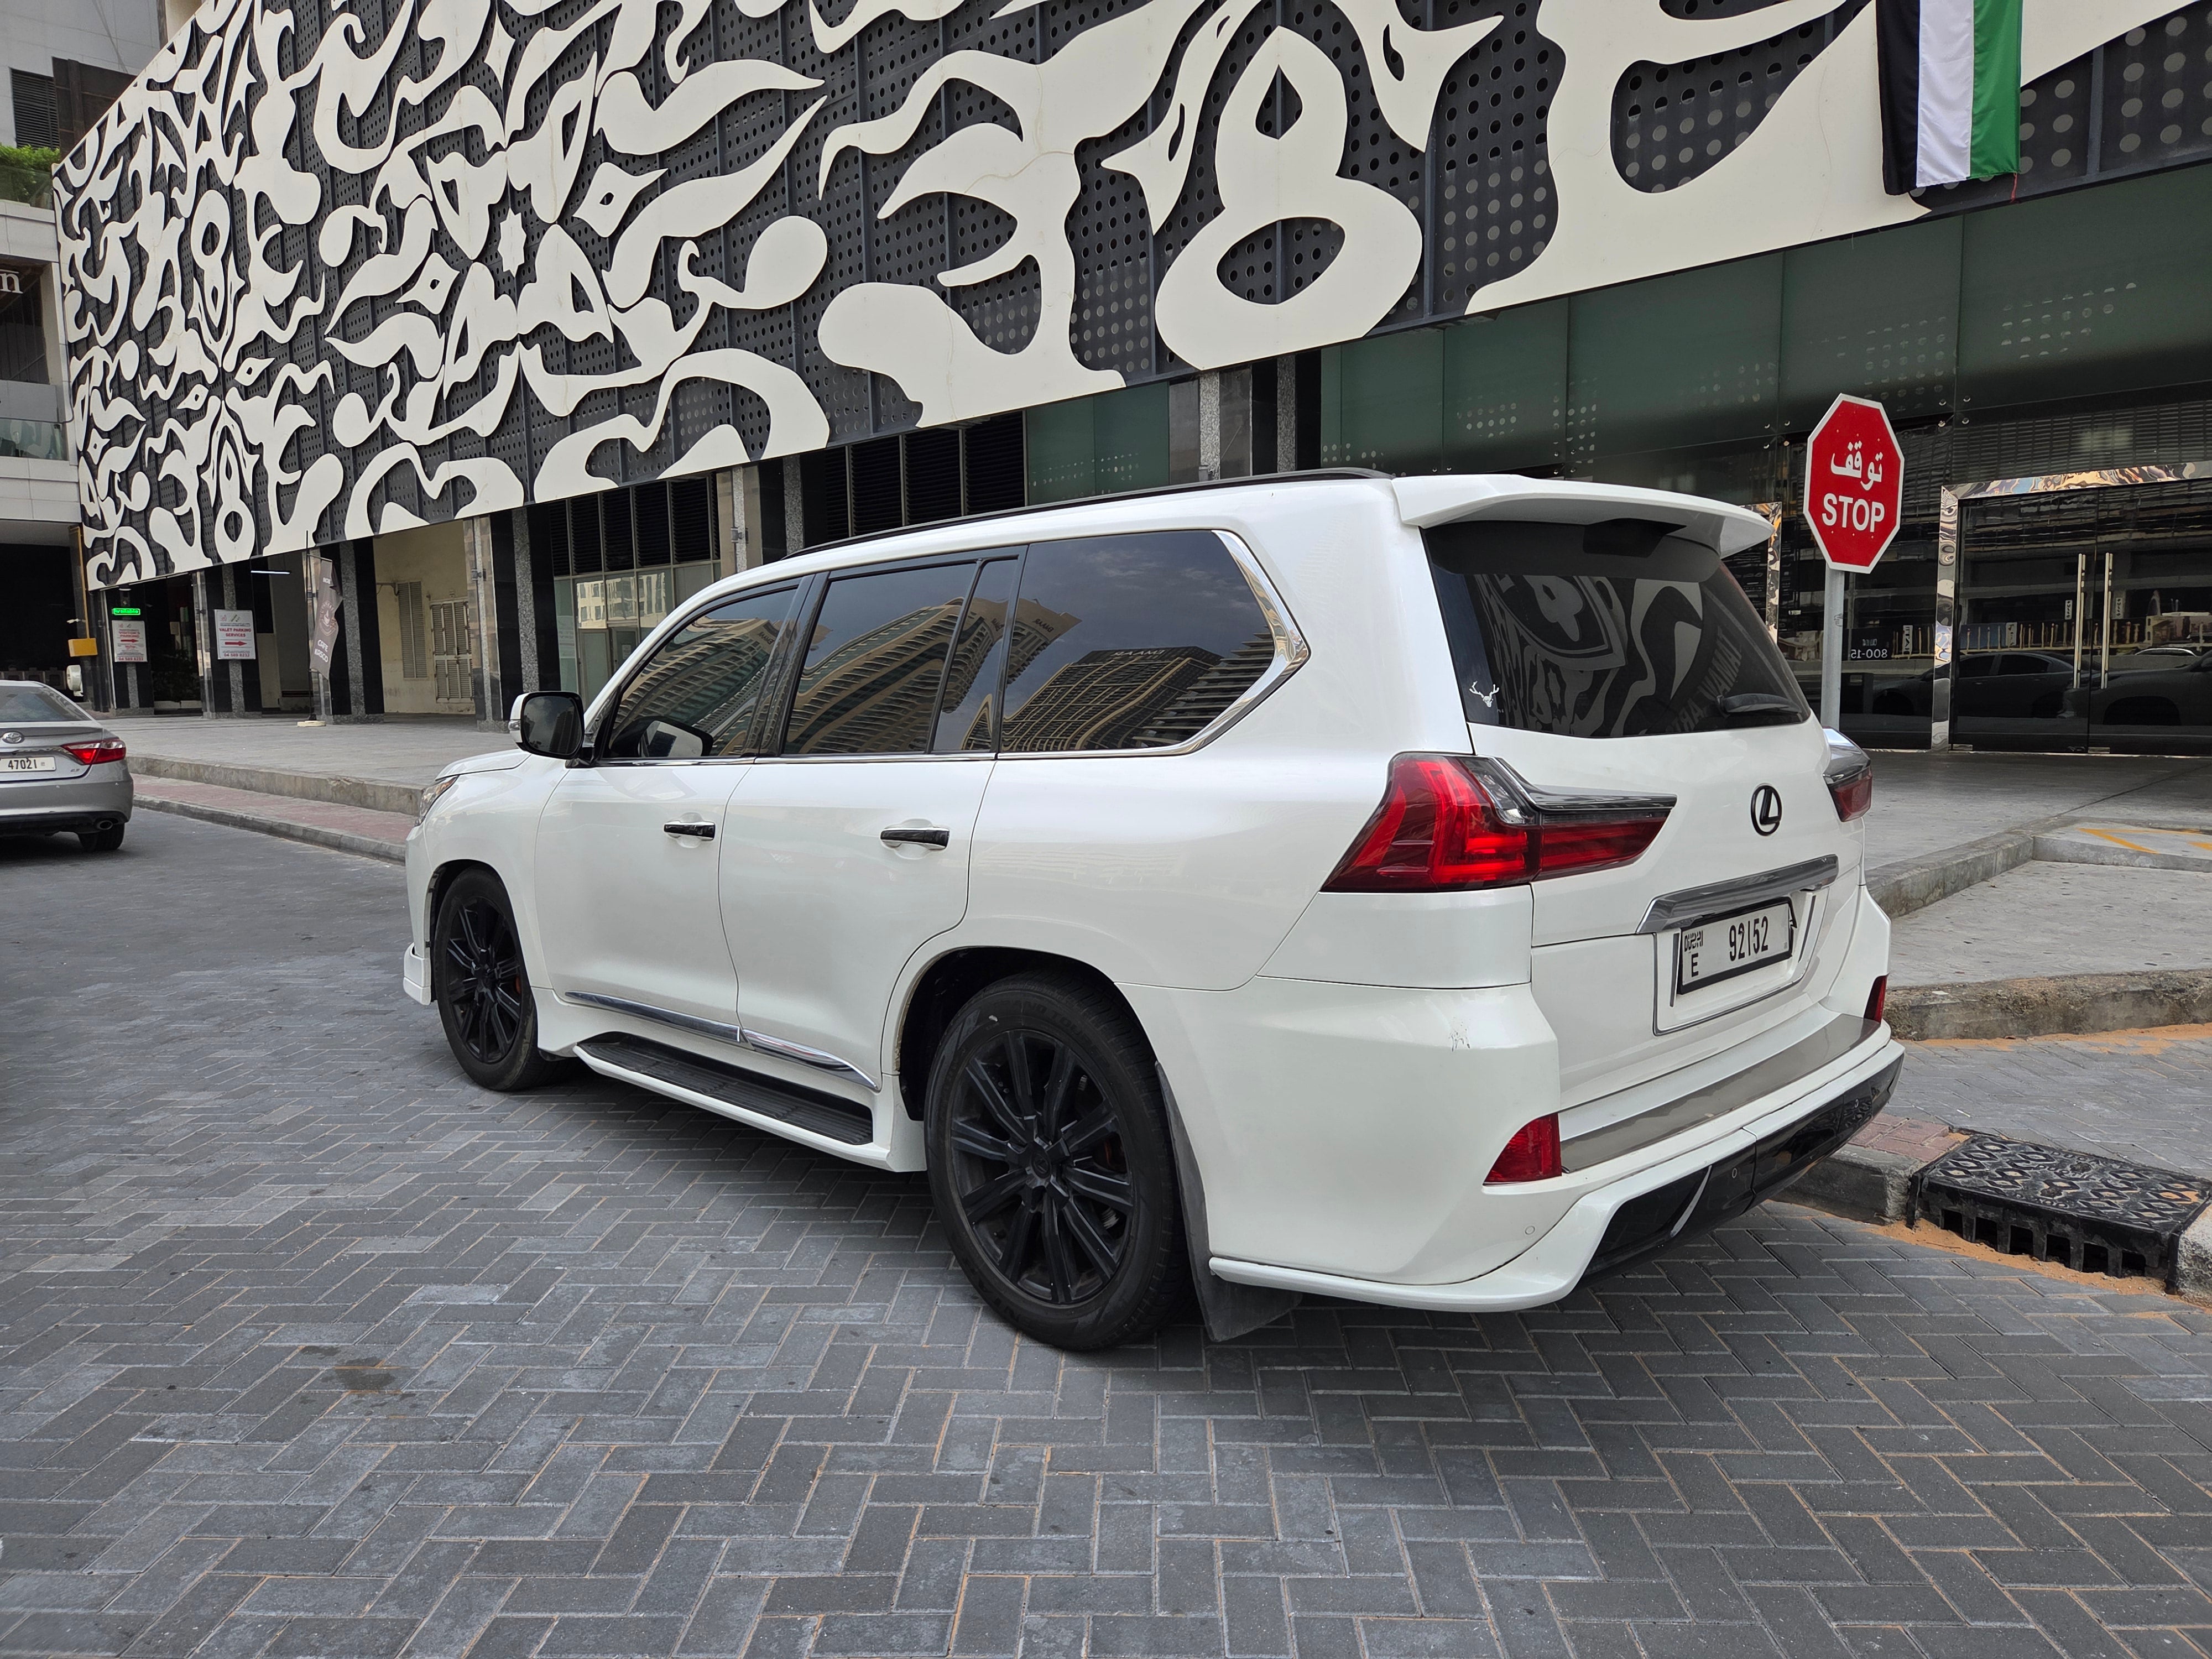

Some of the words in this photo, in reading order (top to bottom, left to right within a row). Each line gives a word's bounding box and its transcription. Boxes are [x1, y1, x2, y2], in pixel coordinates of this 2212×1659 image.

[1830, 440, 1883, 491] توقف
[1822, 493, 1885, 533] STOP
[8, 759, 37, 770] 47021
[1729, 916, 1768, 962] 92152
[1691, 952, 1699, 977] E
